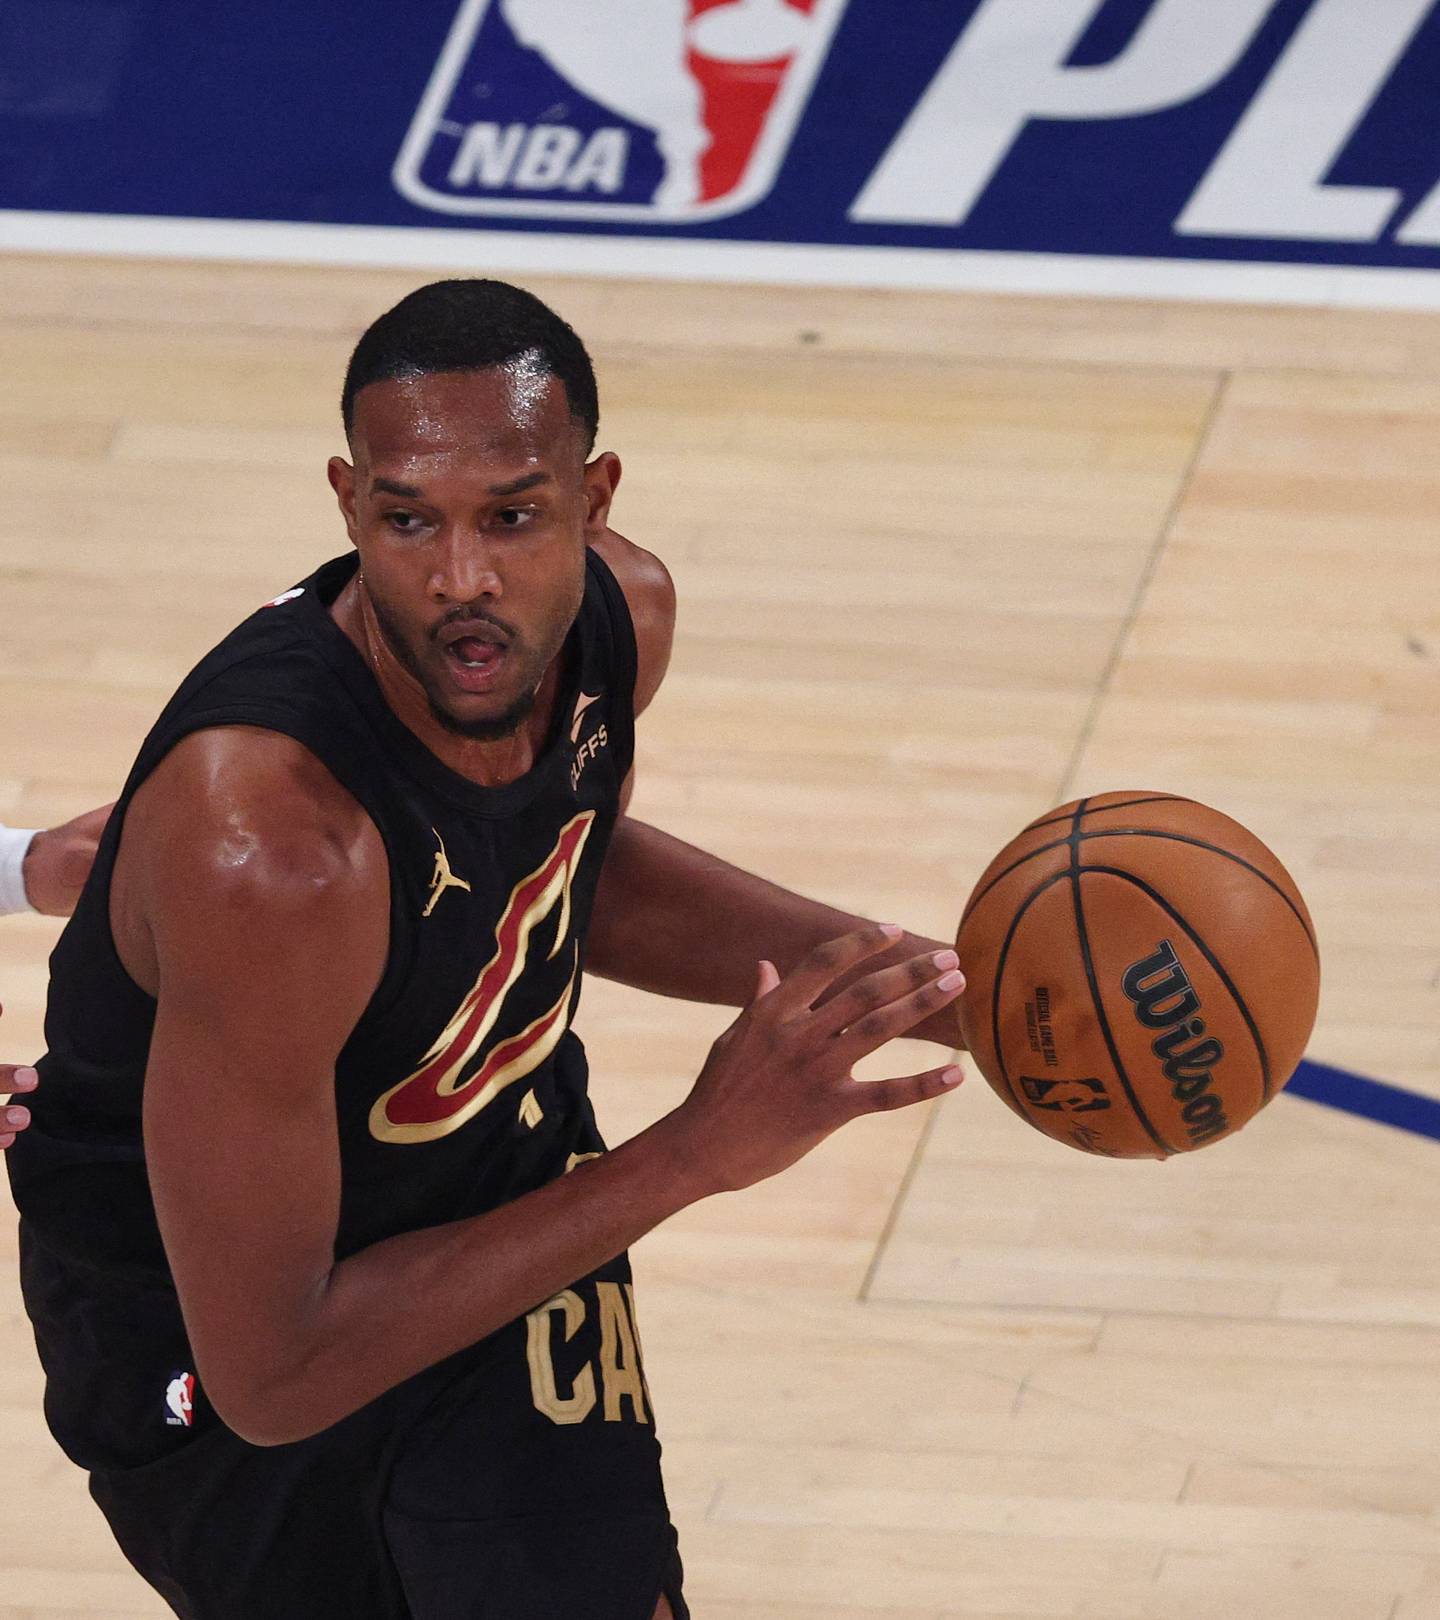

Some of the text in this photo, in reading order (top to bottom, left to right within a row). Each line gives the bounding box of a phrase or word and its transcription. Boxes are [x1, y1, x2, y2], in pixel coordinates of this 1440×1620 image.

[448, 120, 630, 194] NBA
[847, 0, 1440, 245] PL
[1120, 938, 1229, 1146] Wilson
[526, 1281, 655, 1425] CA
